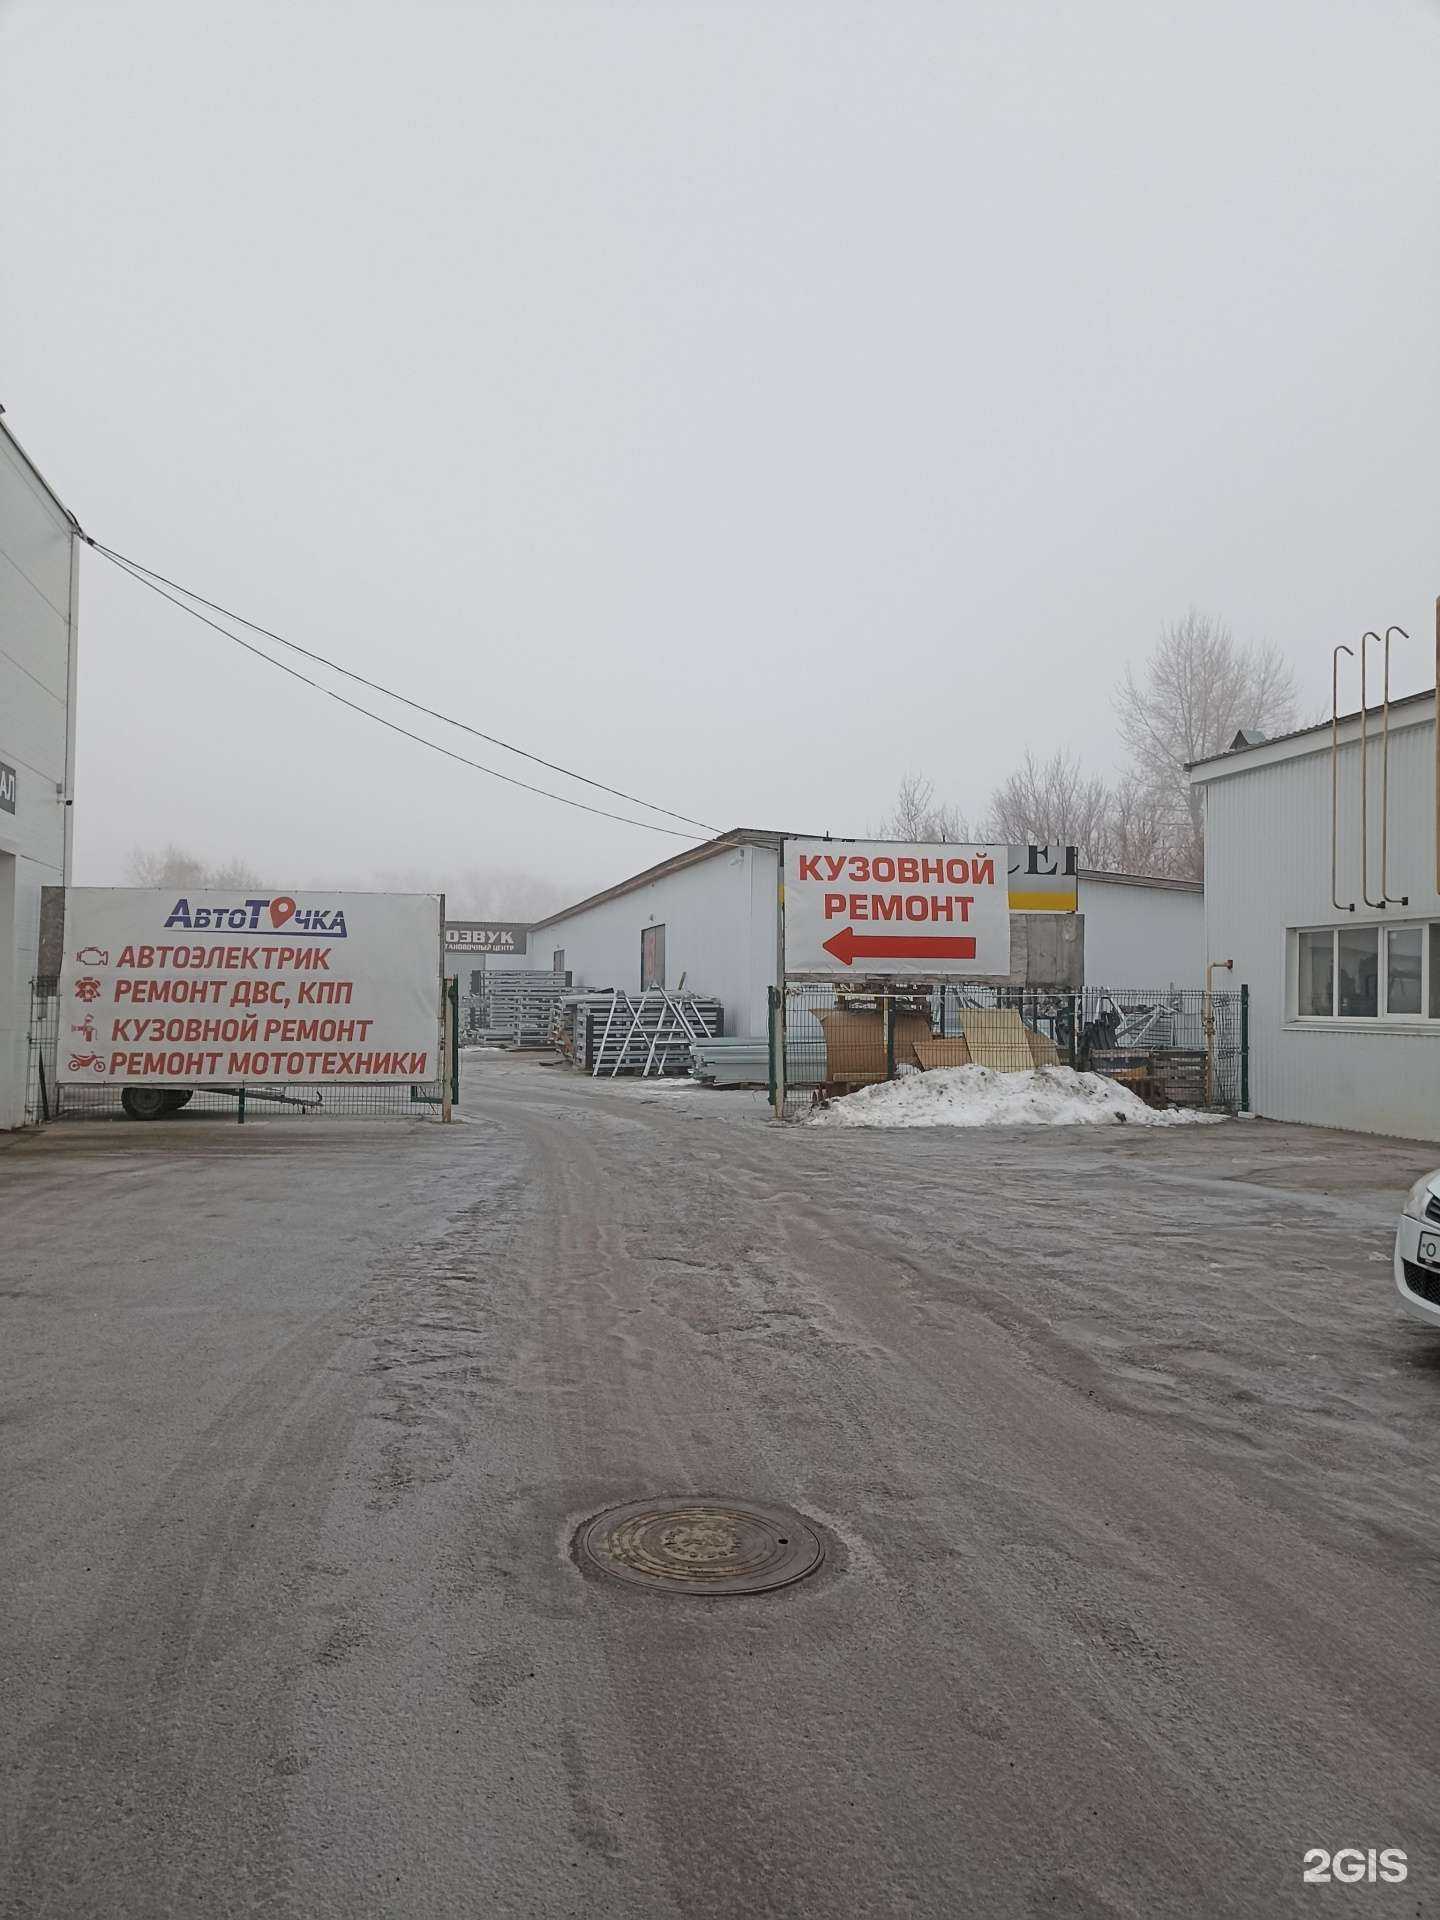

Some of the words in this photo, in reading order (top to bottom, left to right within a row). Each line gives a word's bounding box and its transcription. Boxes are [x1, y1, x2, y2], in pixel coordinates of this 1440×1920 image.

[799, 852, 995, 885] КУЗОВНОЙ
[824, 893, 974, 922] РЕМОНТ
[116, 946, 332, 970] АВТОЭЛЕКТРИК
[114, 980, 227, 1003] РЕМОНТ
[229, 981, 290, 1009] ДВС,
[298, 982, 353, 1004] КПП
[111, 1013, 258, 1042] КУЗОВНОЙ
[264, 1020, 373, 1042] РЕМОНТ
[109, 1052, 222, 1075] РЕМОНТ
[227, 1053, 427, 1075] МОТОТЕХНИКИ
